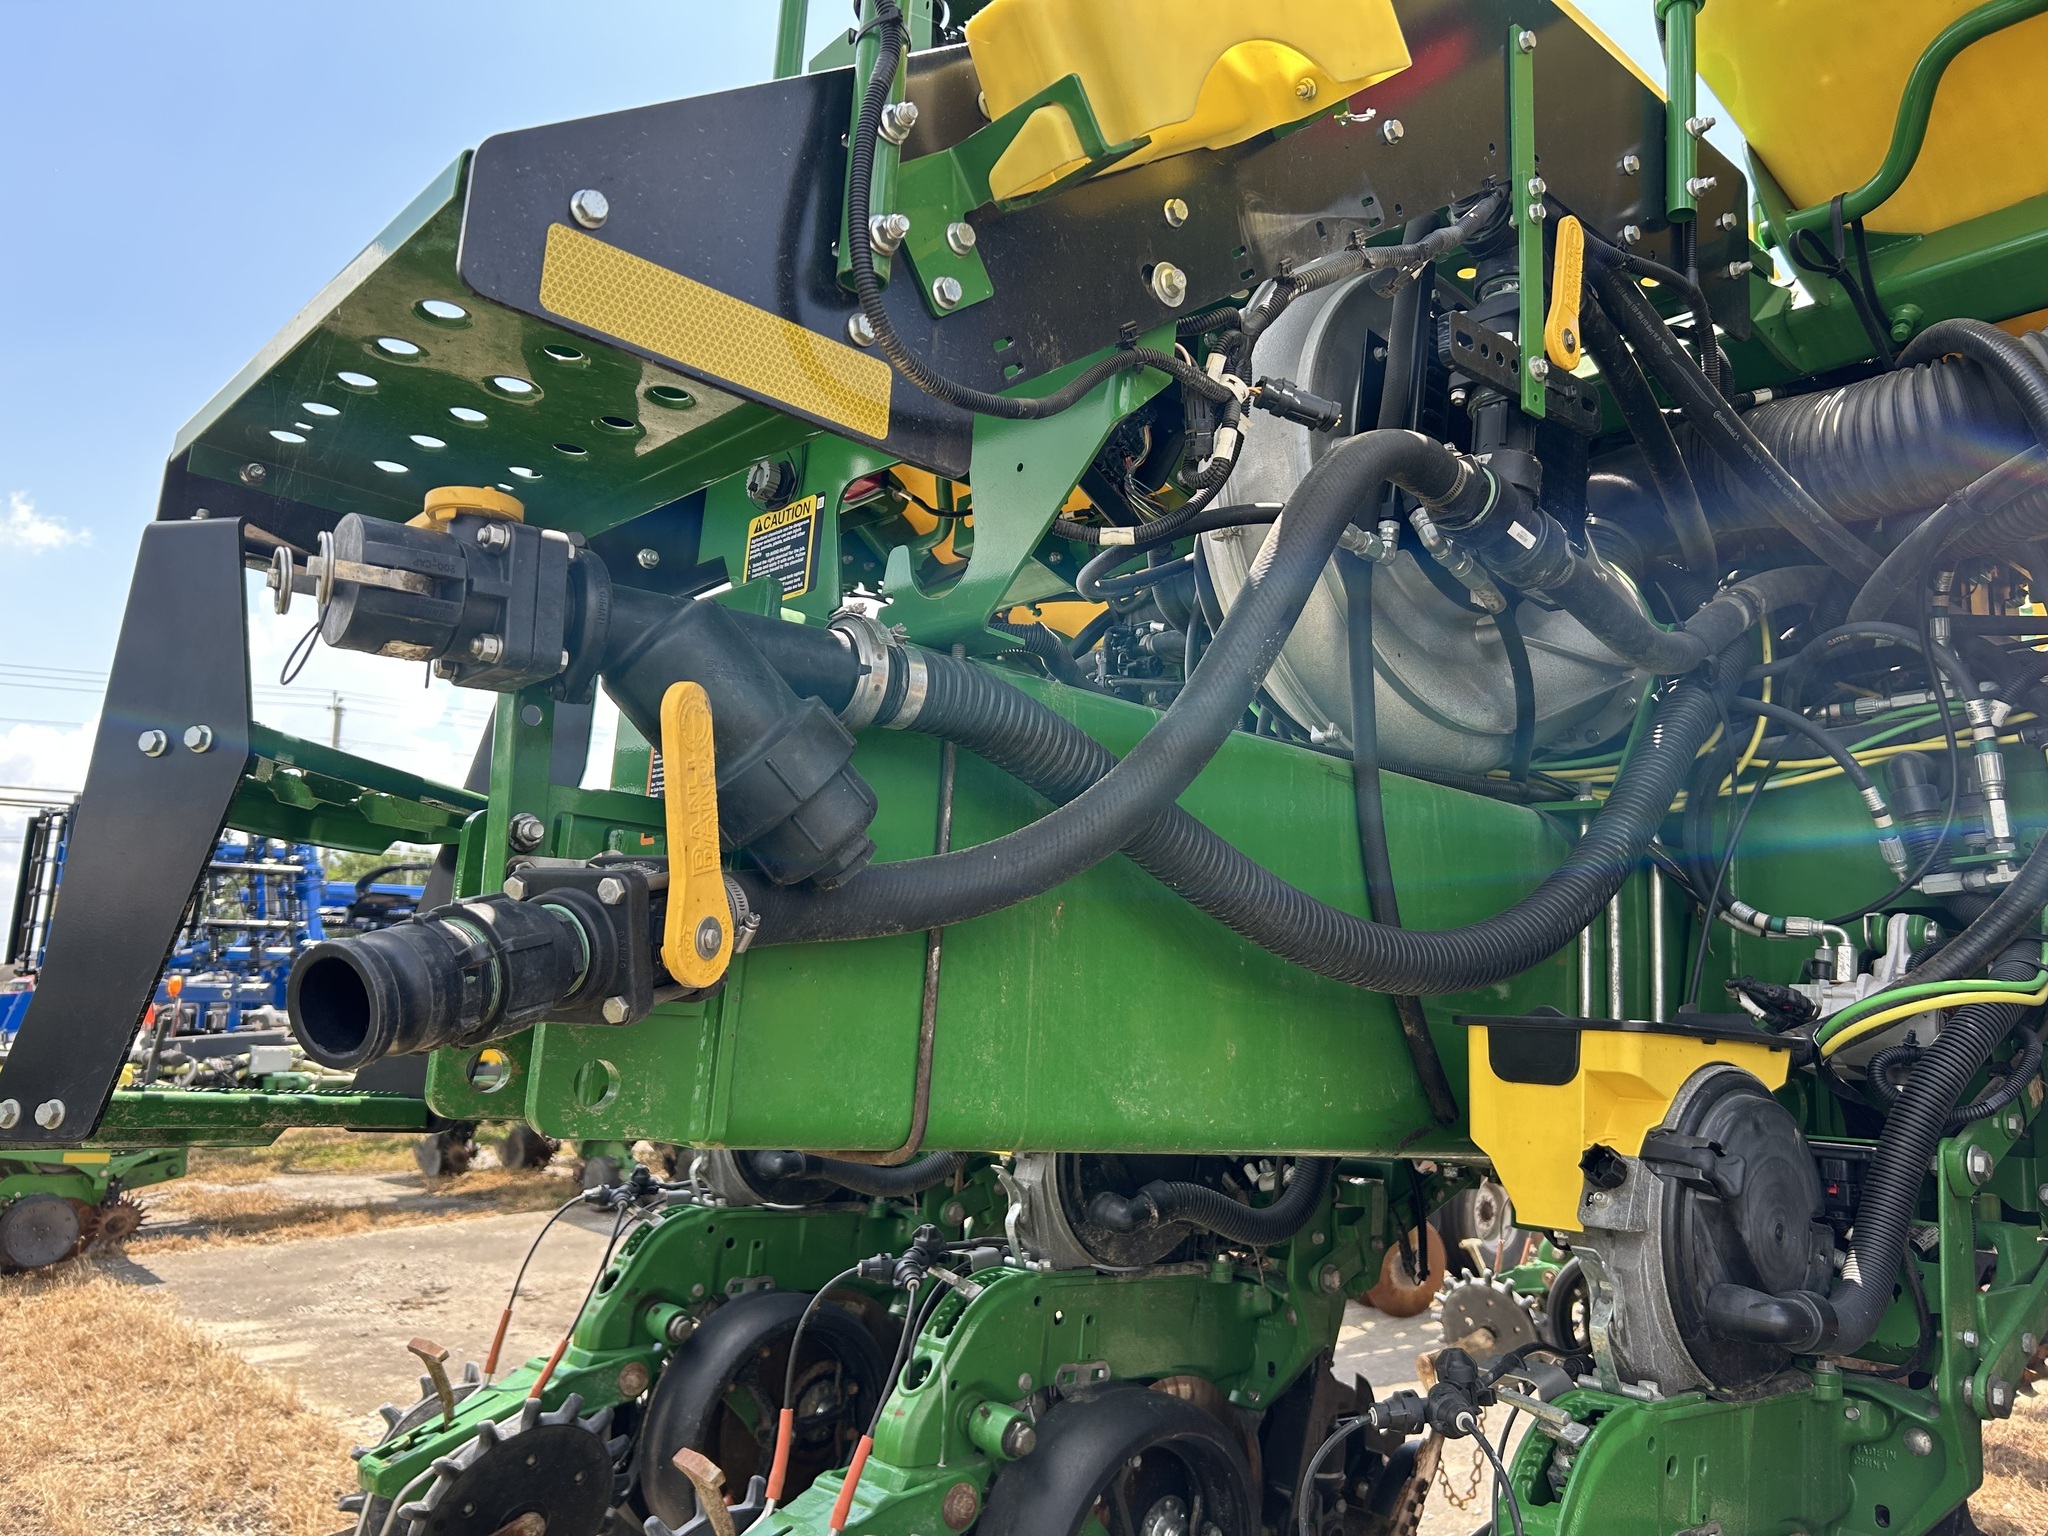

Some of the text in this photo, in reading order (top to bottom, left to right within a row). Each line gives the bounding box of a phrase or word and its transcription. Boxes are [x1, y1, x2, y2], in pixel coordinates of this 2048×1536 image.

[764, 500, 811, 530] CAUTION
[412, 557, 456, 574] 200-CAP
[1826, 634, 1850, 647] GATES
[687, 757, 720, 876] BANJO
